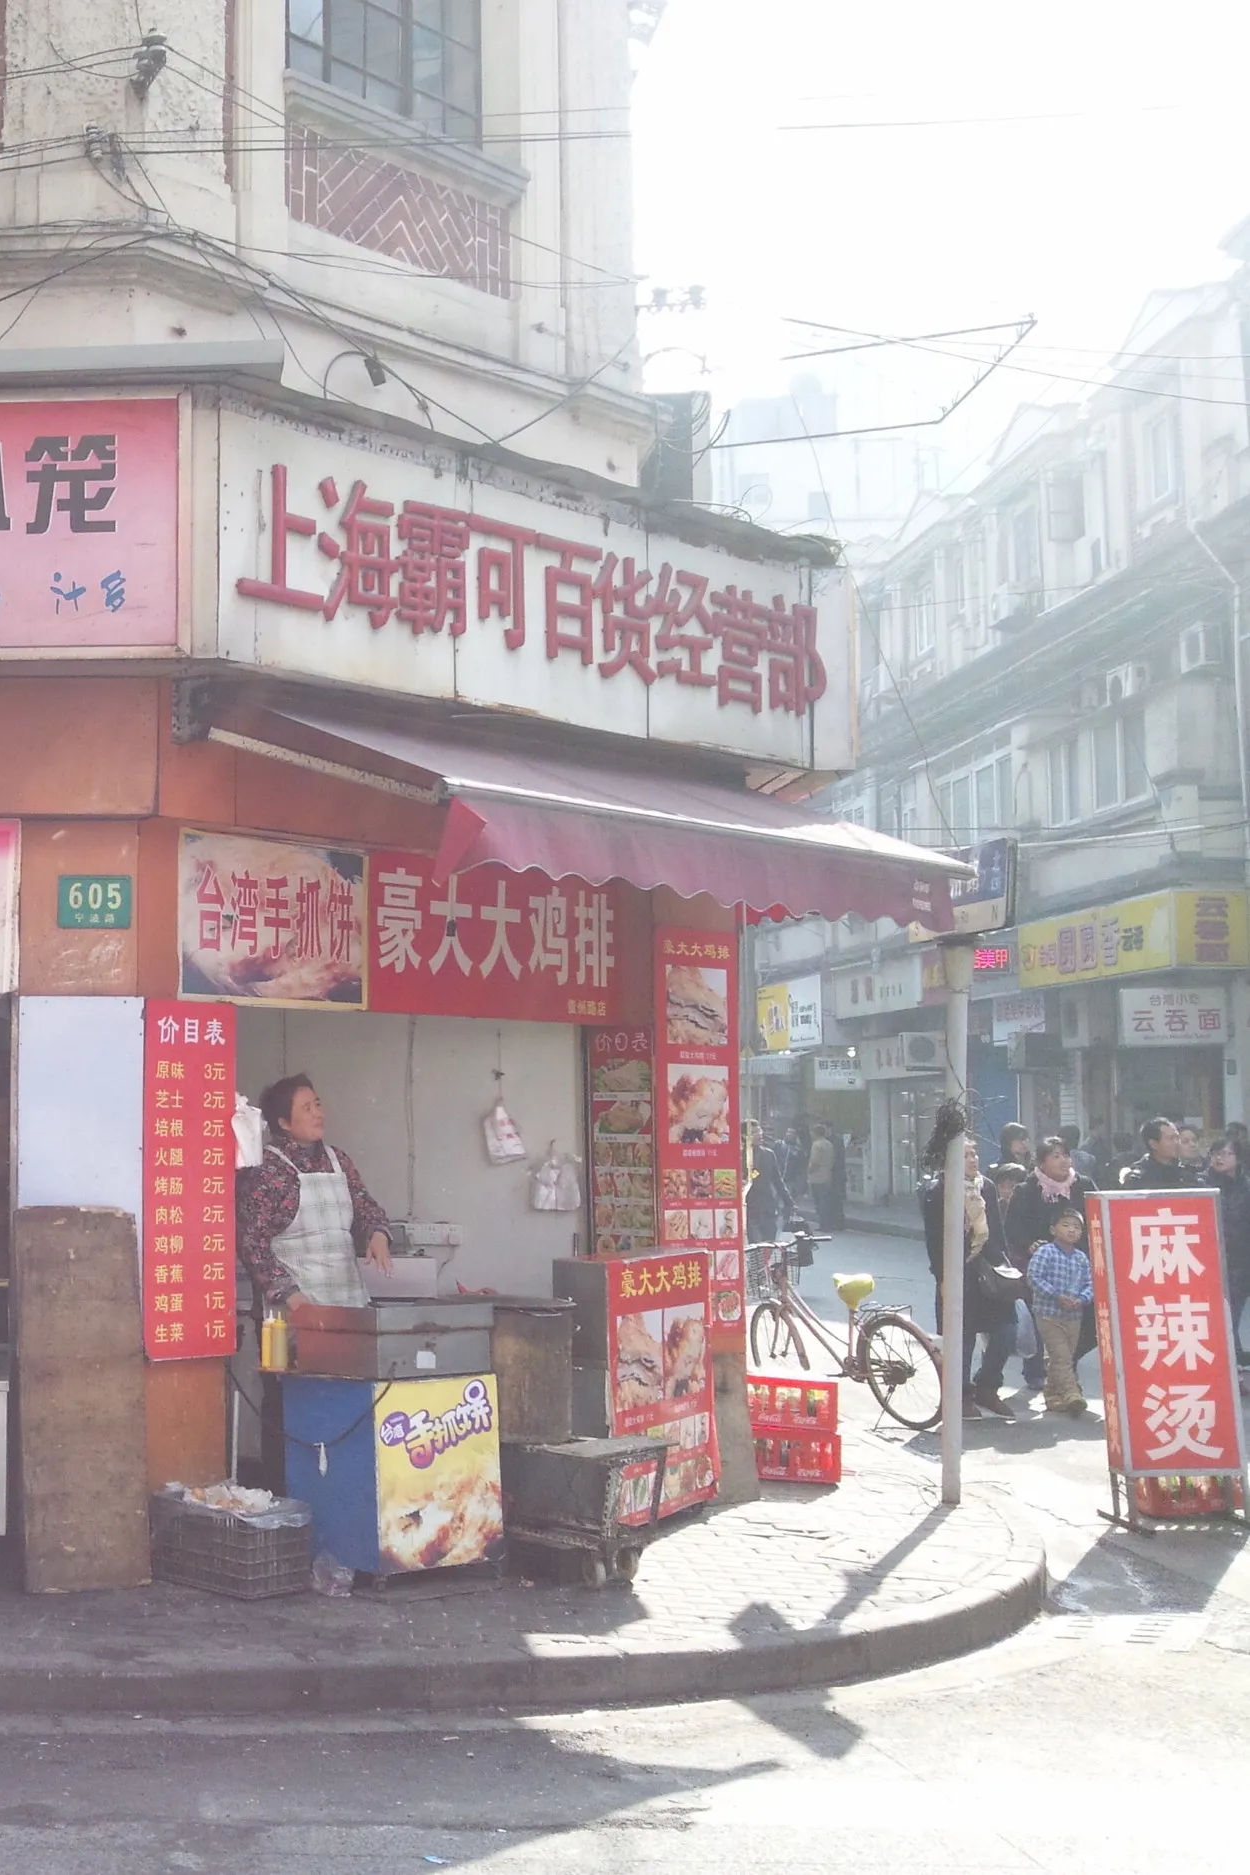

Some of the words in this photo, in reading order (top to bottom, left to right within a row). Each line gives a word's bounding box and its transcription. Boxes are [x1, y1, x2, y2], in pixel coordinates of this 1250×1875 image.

[236, 464, 828, 716] 上海霸可百货经营部
[68, 882, 123, 910] 605
[196, 865, 354, 960] 台湾手抓饼
[378, 867, 615, 987] 豪大大鸡排
[158, 1016, 226, 1045] 价目表
[1132, 1009, 1221, 1032] 云吞面
[155, 1061, 185, 1080] 原味
[204, 1063, 225, 1080] 3元
[155, 1090, 183, 1108] 芝士
[203, 1092, 225, 1109] 2元
[154, 1119, 184, 1137] 培根
[203, 1120, 225, 1137] 2元
[154, 1148, 184, 1166] 火腿
[203, 1148, 225, 1166] 2元
[154, 1176, 183, 1195] 烤肠
[203, 1177, 225, 1194] 2元
[155, 1206, 183, 1225] 肉松
[203, 1205, 225, 1223] 2元
[154, 1235, 183, 1254] 鸡柳
[203, 1234, 225, 1252] 2元
[155, 1264, 183, 1283] 香蕉
[203, 1263, 225, 1280] 2元
[620, 1261, 703, 1298] 豪大大鸡排
[155, 1293, 183, 1313] 鸡蛋
[205, 1291, 226, 1309] 1元
[155, 1323, 184, 1343] 生菜
[205, 1320, 226, 1338] 1元
[1128, 1207, 1224, 1461] 麻辣烫
